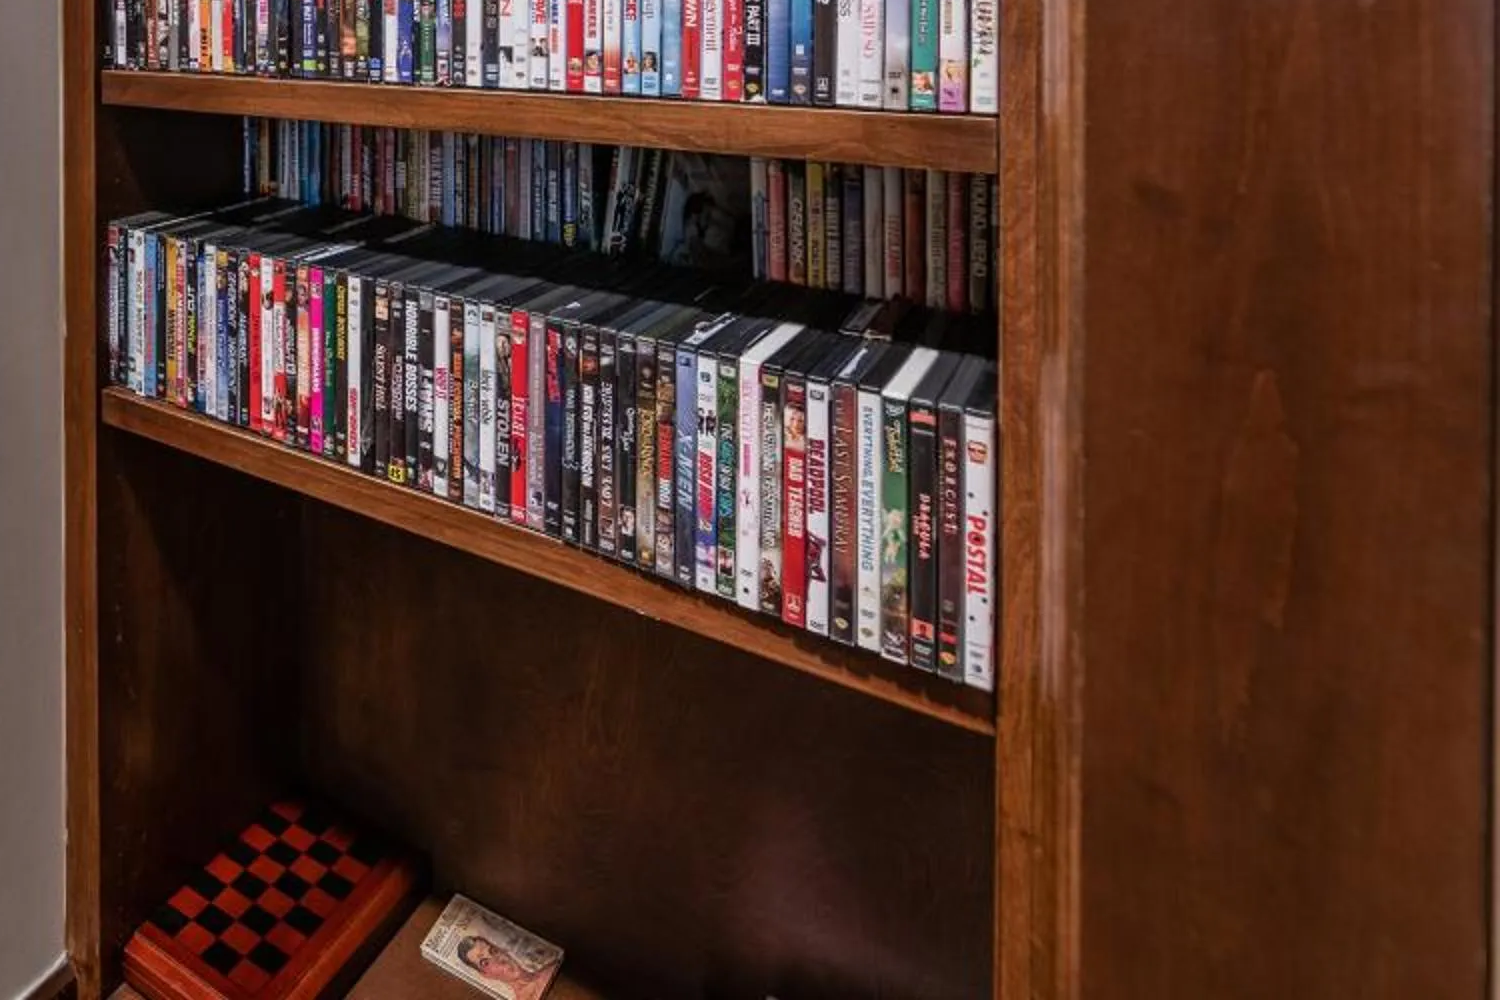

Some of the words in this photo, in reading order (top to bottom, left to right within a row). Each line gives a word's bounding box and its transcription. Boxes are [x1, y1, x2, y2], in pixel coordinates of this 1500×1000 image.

[746, 5, 760, 31] PART
[747, 32, 761, 46] III
[404, 299, 417, 362] HORRIBLE
[375, 344, 387, 381] SILENT
[404, 364, 417, 412] BOSSES
[375, 384, 387, 411] HILL
[497, 399, 509, 467] STOLEN
[833, 425, 853, 467] LAST
[678, 430, 693, 512] X-MEN
[698, 450, 712, 484] RUSH
[788, 456, 803, 481] BAD
[809, 438, 825, 515] DEADPOOL
[943, 436, 958, 533] EXORCIST
[788, 485, 803, 539] TEACHER
[833, 471, 853, 553] SAMURAI
[860, 479, 875, 572] EVERYTHING
[919, 493, 931, 560] DRACULA
[966, 514, 987, 598] POSTAL
